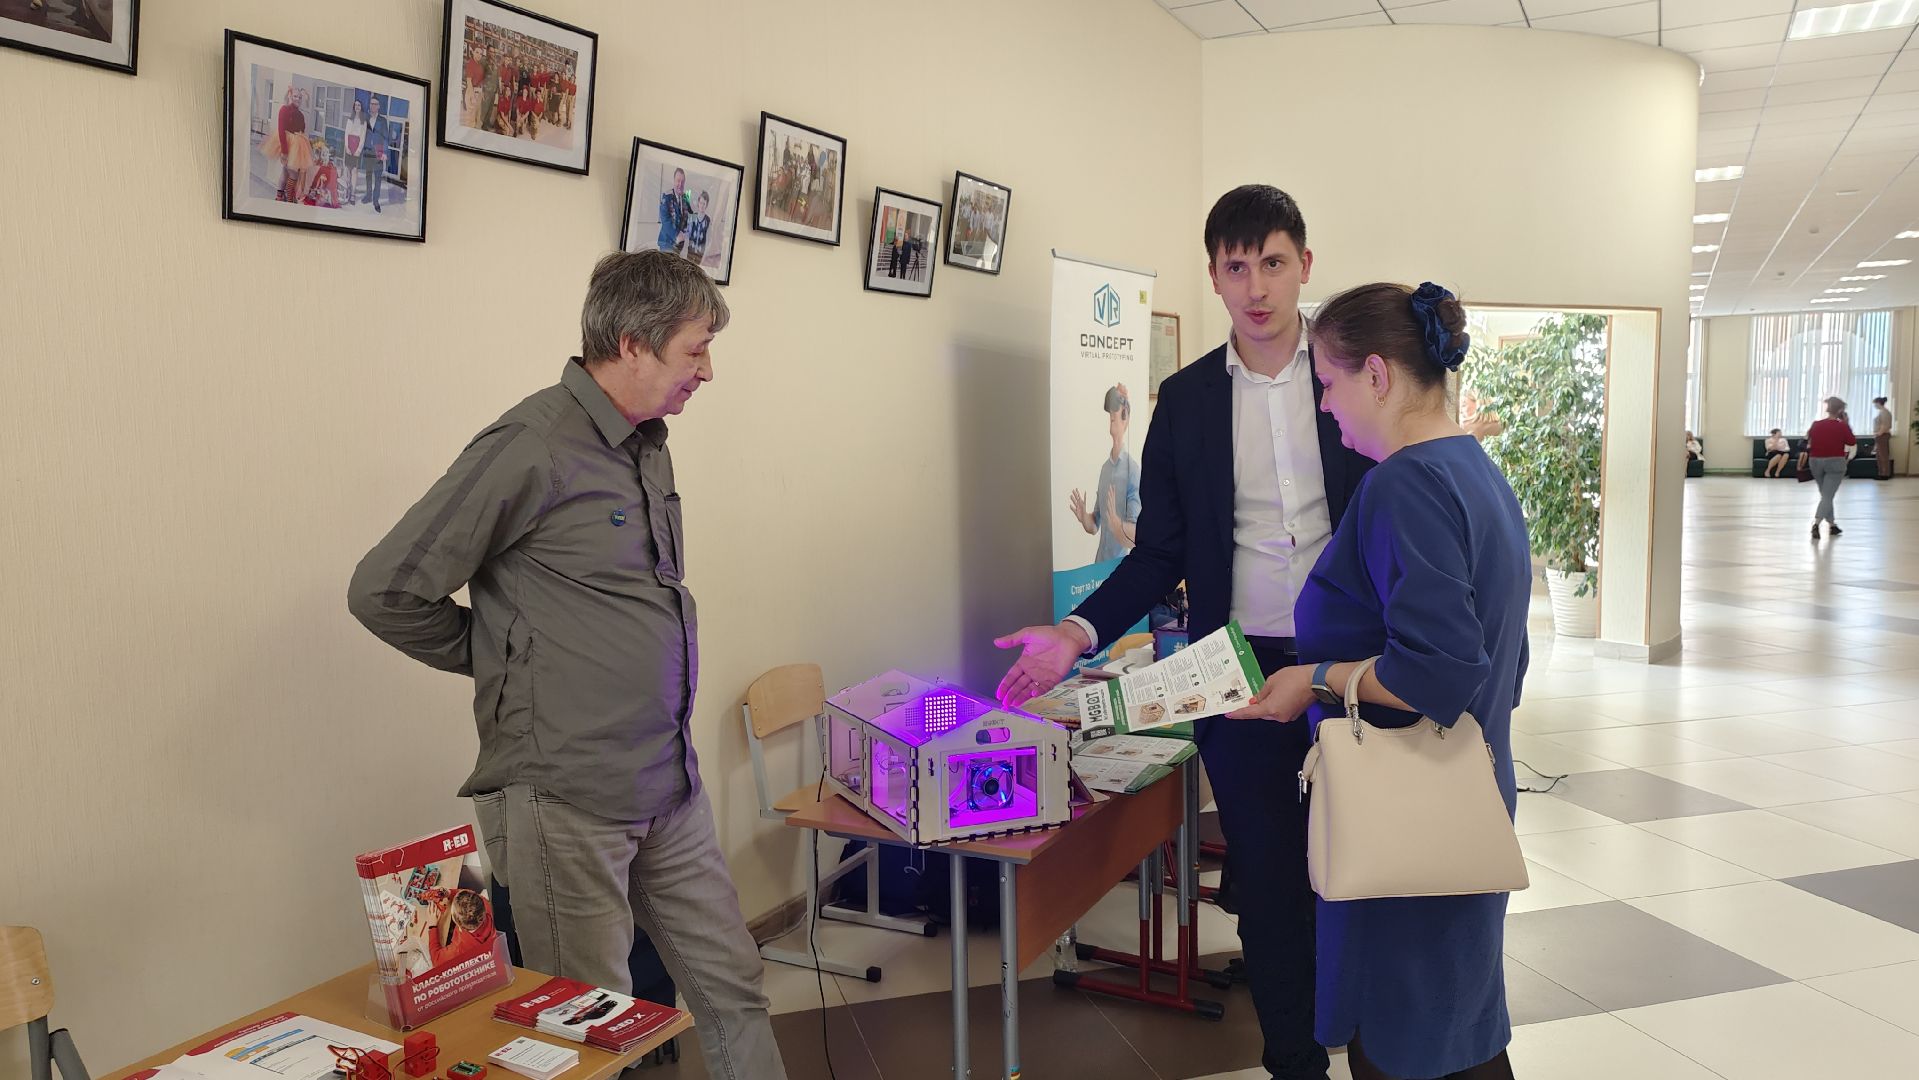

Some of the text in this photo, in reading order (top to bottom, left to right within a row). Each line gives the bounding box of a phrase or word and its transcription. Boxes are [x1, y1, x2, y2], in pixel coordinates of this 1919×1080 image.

[1096, 291, 1119, 321] VR
[1080, 333, 1134, 350] CONCEPT
[1080, 351, 1134, 361] VIRTUAL PROTOTYPING
[1085, 691, 1102, 724] MGBOT
[412, 951, 492, 993] КЛАСС-КОМПЛЕКТЫ
[413, 960, 496, 1005] ПО РОБОТОТЕХНИКЕ
[417, 1005, 424, 1013] от
